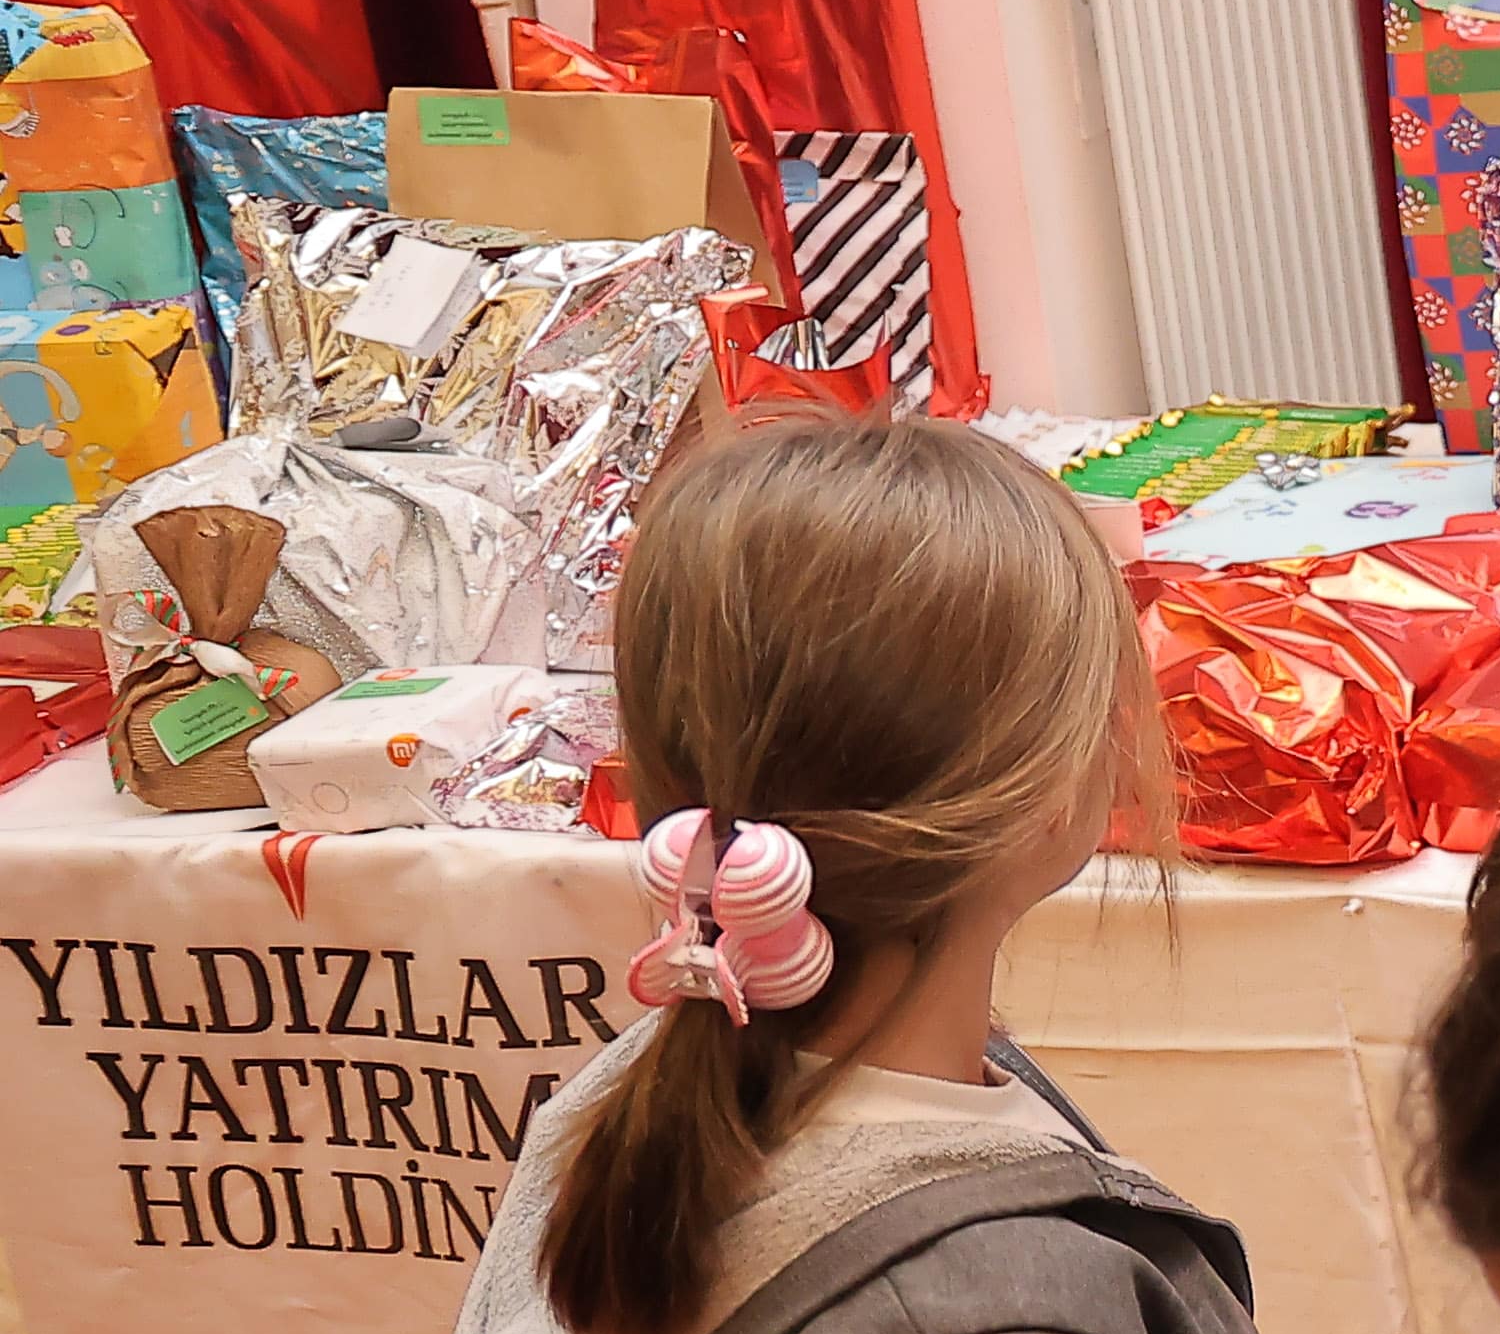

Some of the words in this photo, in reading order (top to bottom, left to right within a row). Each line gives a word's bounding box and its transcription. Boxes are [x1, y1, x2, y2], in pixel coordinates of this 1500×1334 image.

[0, 938, 621, 1049] YILDIZLAR
[86, 1052, 561, 1162] YATIRIM
[118, 1158, 496, 1263] HOLDİN
